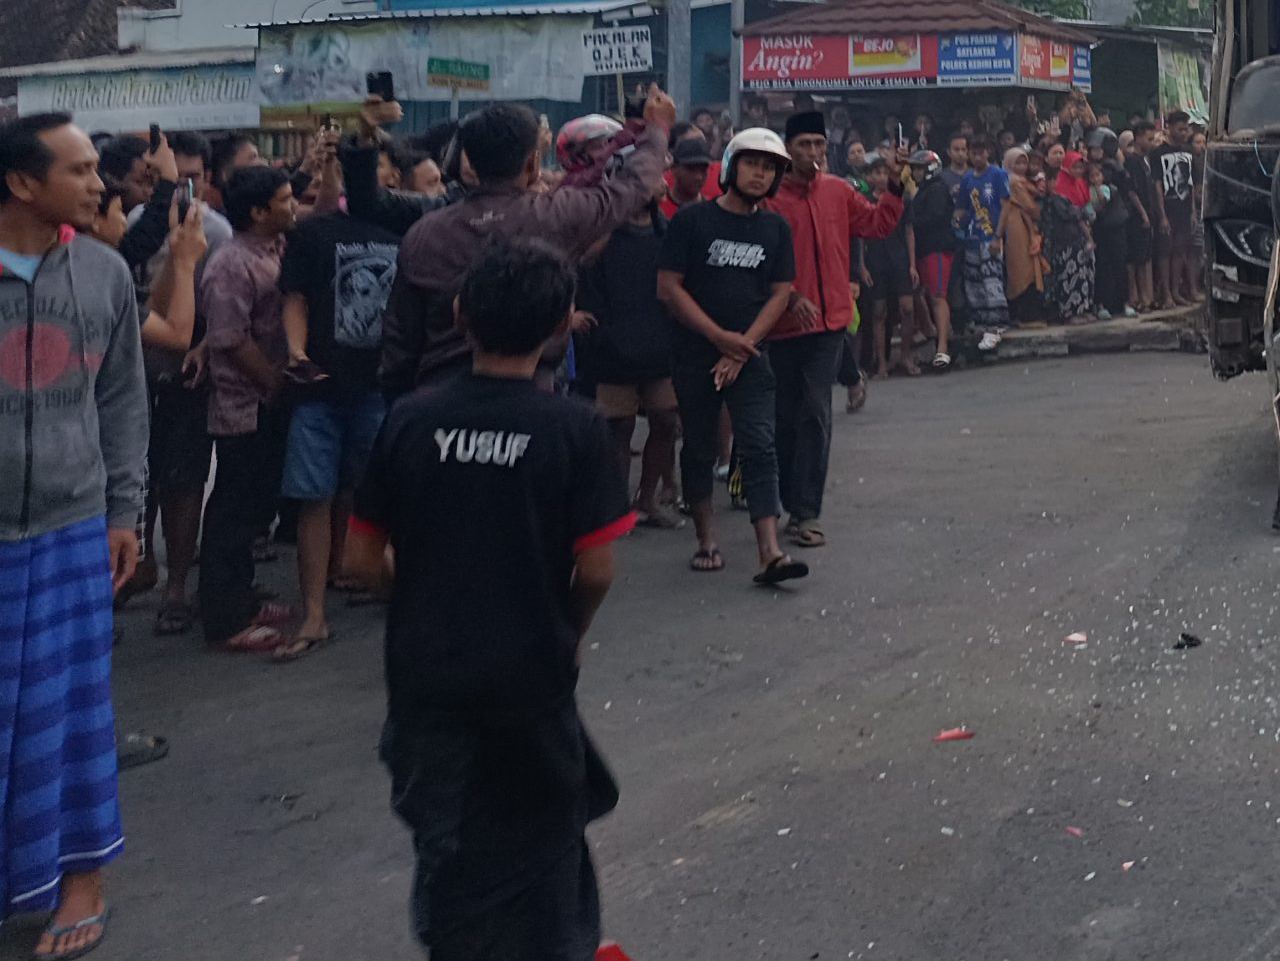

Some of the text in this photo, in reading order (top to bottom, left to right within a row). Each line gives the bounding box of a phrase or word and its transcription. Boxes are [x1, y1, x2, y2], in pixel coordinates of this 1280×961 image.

[760, 37, 814, 49] MASUK
[864, 39, 894, 52] BEJO
[434, 428, 531, 468] YUSUF
